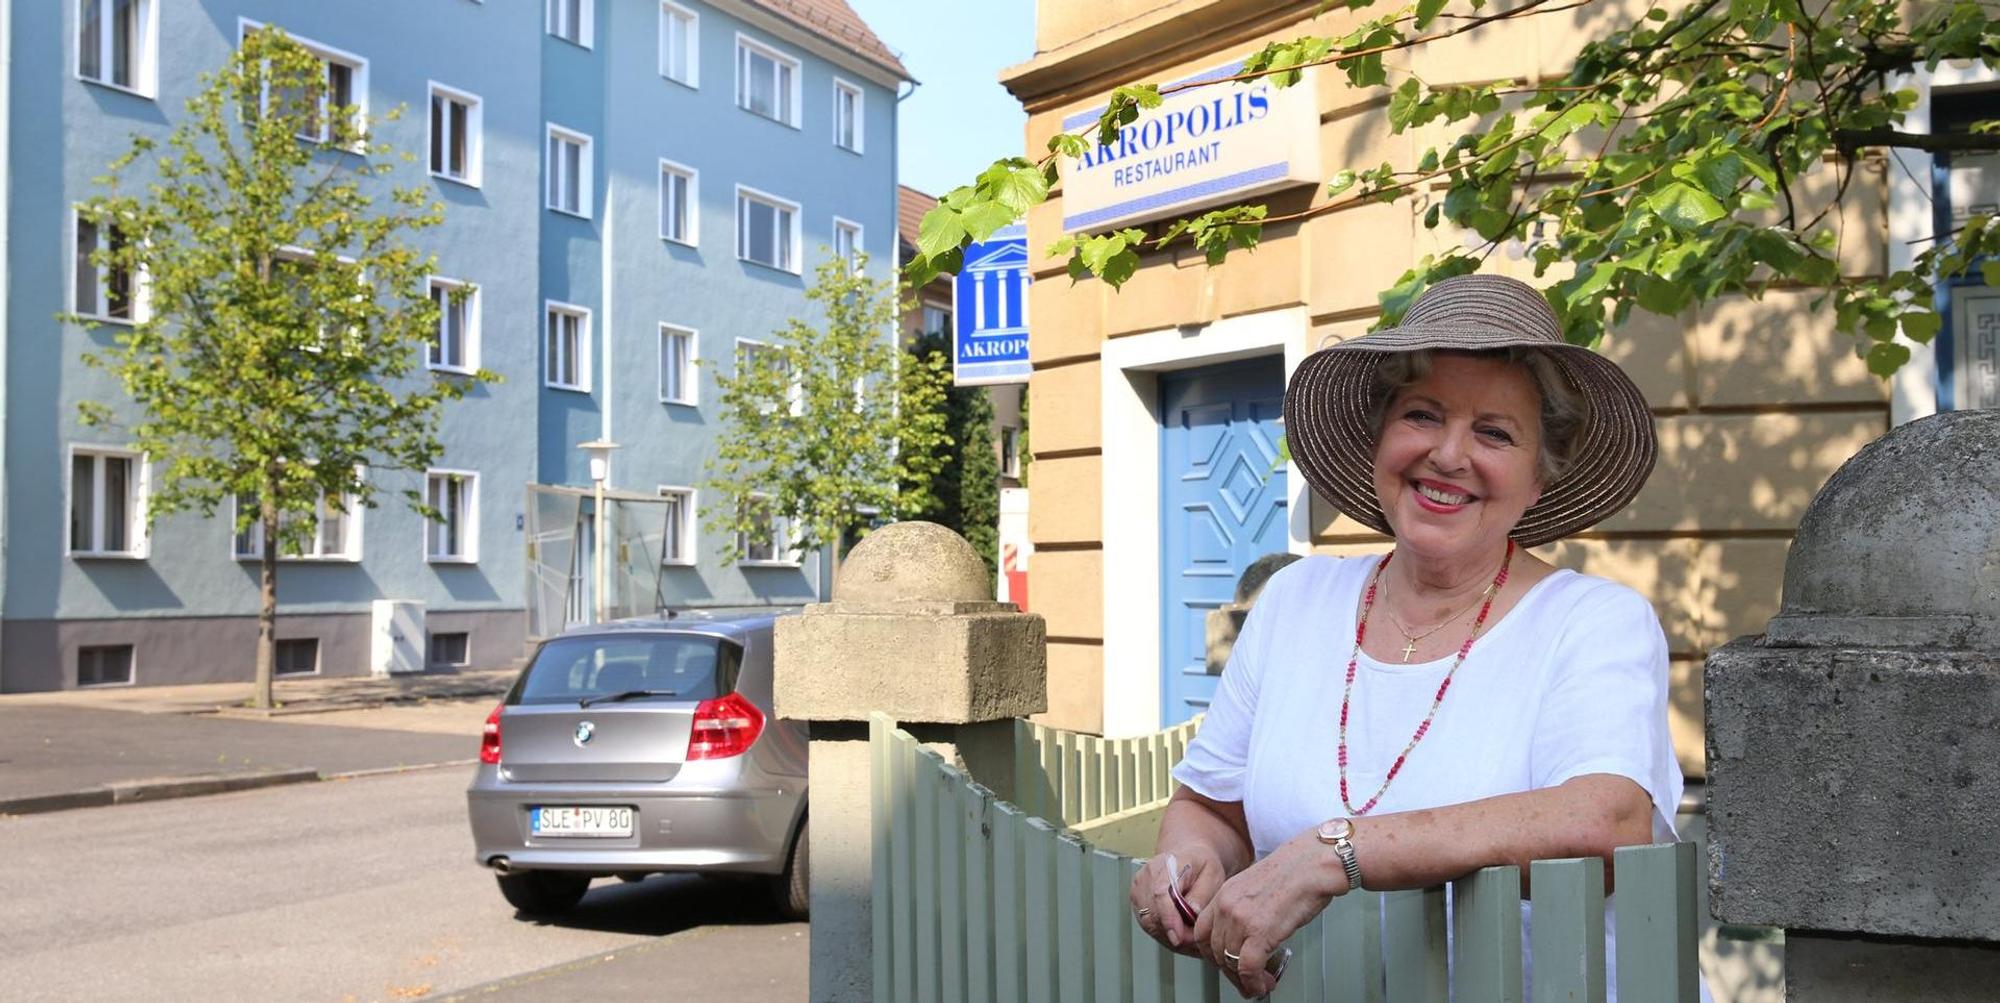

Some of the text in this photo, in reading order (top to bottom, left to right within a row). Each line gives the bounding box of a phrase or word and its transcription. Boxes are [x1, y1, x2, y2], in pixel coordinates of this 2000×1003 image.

[1114, 141, 1221, 187] RESTAURANT
[961, 339, 1029, 357] AKROP
[542, 809, 629, 829] SLE PV 80
